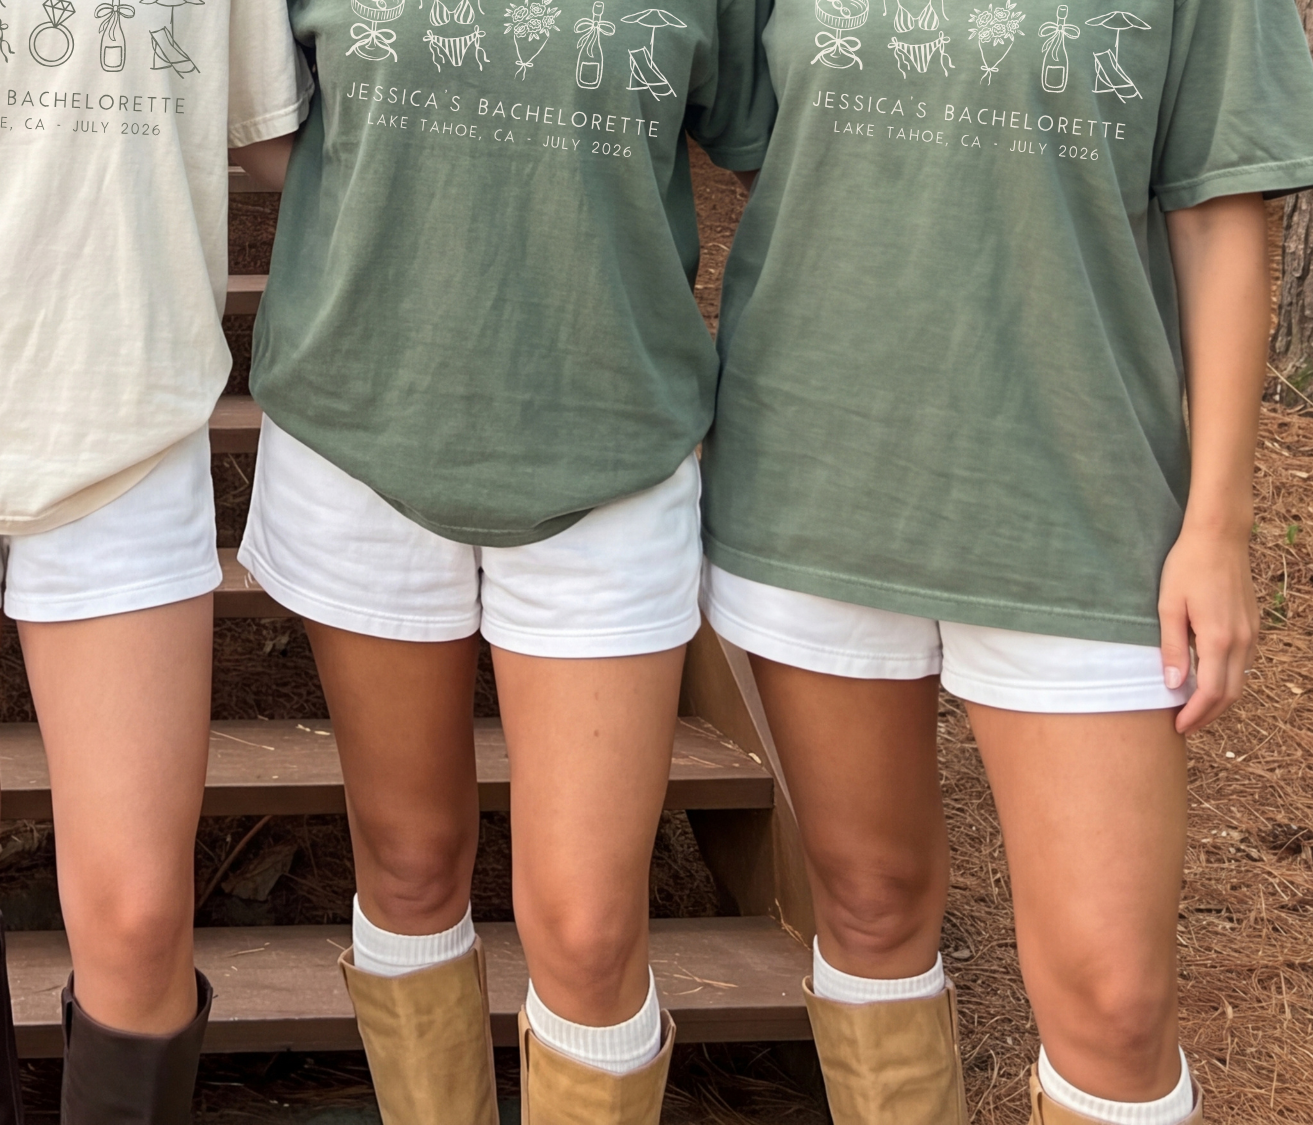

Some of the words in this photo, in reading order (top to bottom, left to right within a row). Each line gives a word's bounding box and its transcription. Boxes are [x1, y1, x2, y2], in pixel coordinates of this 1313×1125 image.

[7, 89, 186, 115] BACHELORETTE
[347, 81, 461, 112] JESSICA'S
[478, 97, 660, 138] BACHELORETTE
[813, 90, 927, 119] JESSICA'S
[944, 104, 1126, 140] BACHELORETTE
[24, 116, 45, 131] CA
[72, 119, 110, 134] JULY
[121, 122, 161, 136] 2026
[367, 111, 409, 129] LAKE
[420, 119, 482, 141] TAHOE,
[494, 128, 515, 143] CA
[542, 134, 580, 152] JULY
[591, 141, 632, 158] 2026
[834, 120, 875, 137] LAKE
[886, 126, 949, 147] TAHOE,
[961, 134, 982, 149] CA
[1009, 140, 1048, 155] JULY
[1059, 144, 1100, 161] 2026
